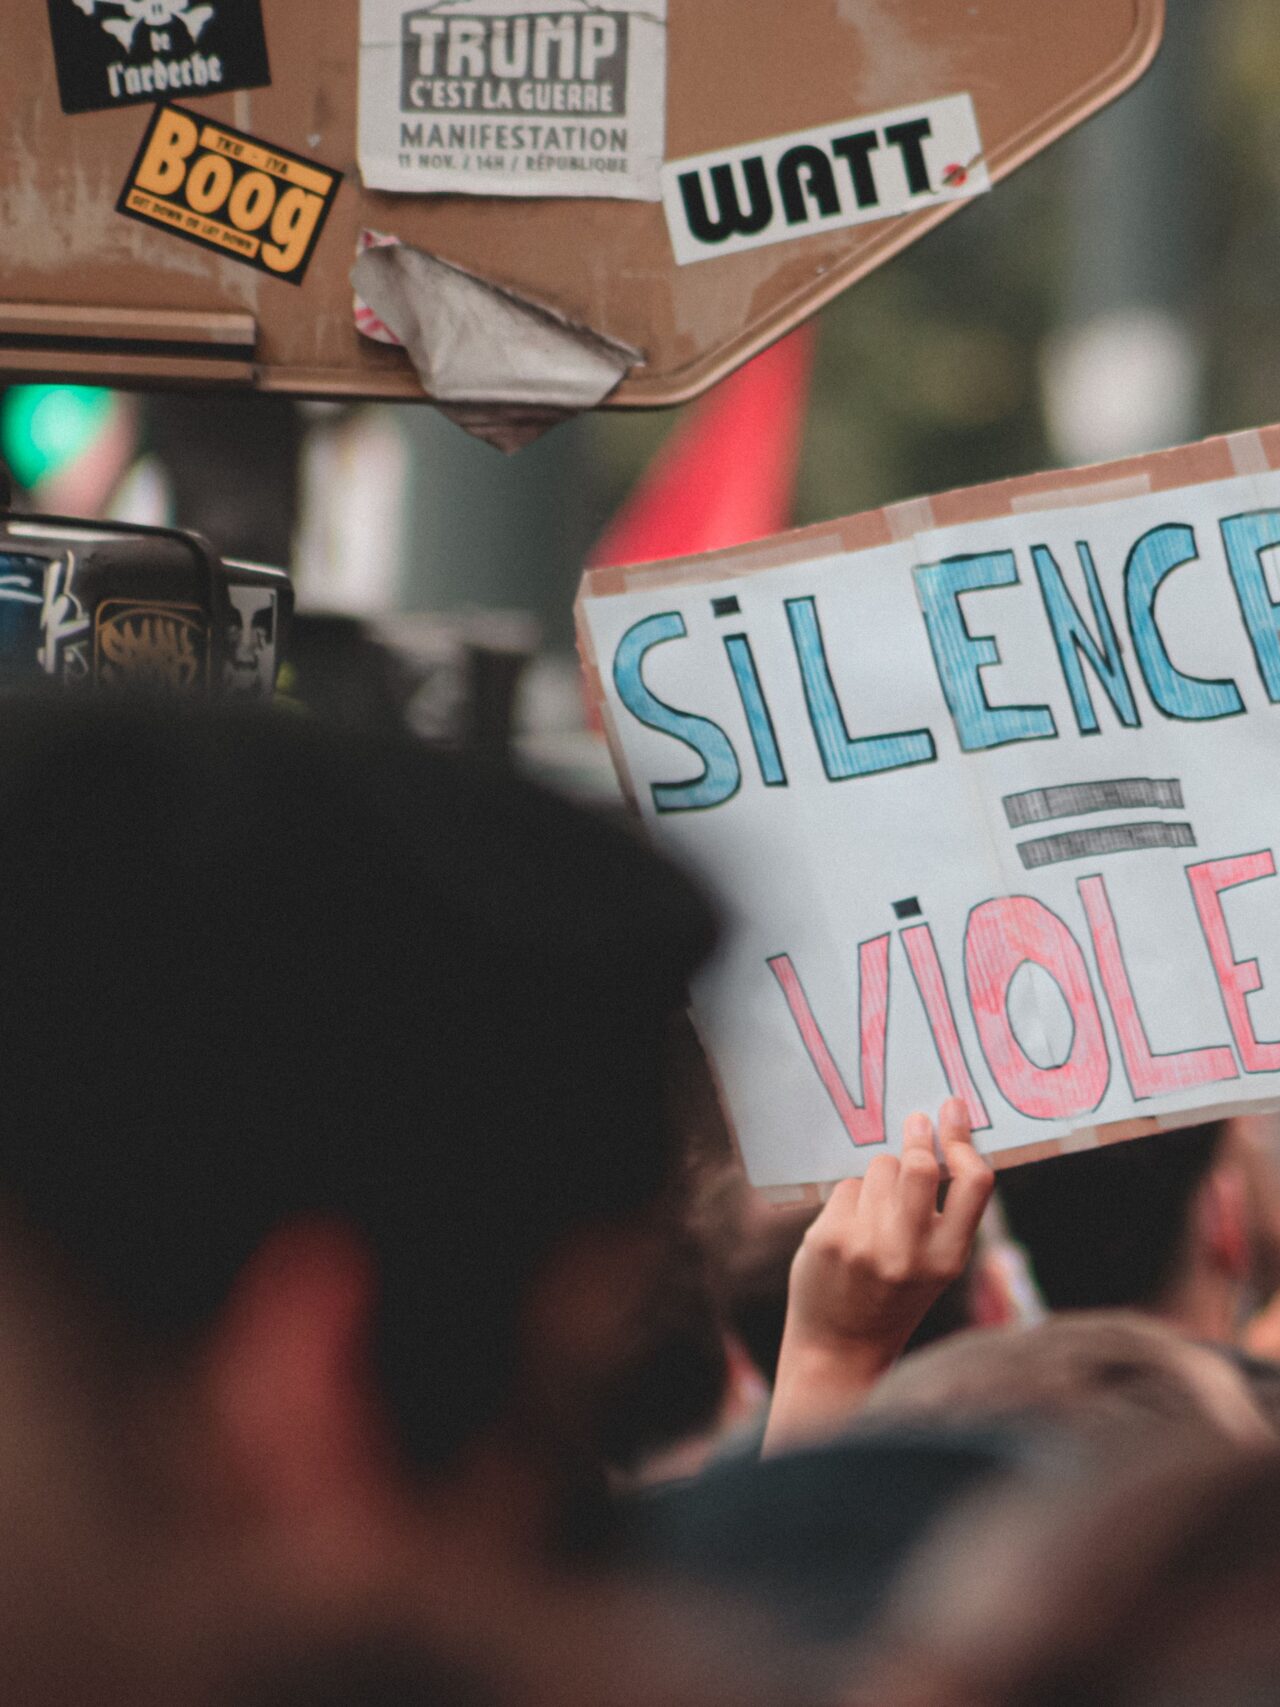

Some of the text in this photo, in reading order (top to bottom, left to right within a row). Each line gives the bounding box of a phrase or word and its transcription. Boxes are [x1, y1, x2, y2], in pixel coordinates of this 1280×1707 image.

[409, 15, 617, 80] TRUMP
[409, 80, 614, 112] C'EST LA GUERRE
[400, 122, 628, 152] MANIFESTATION
